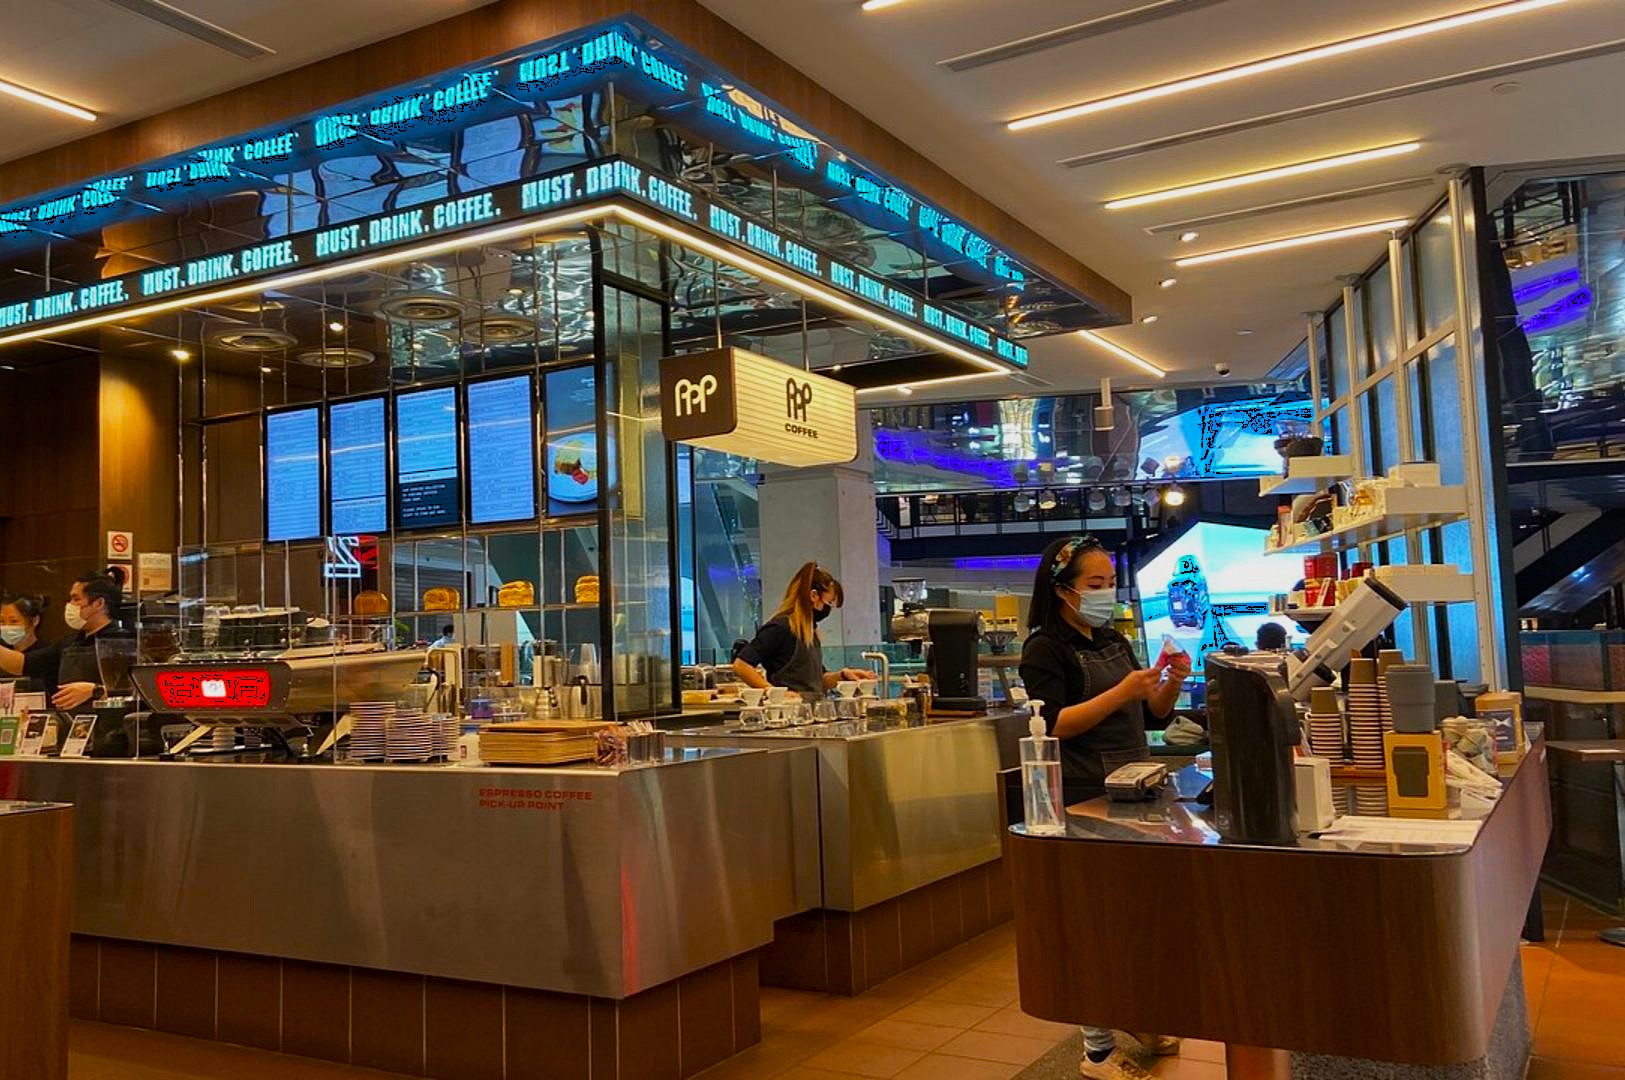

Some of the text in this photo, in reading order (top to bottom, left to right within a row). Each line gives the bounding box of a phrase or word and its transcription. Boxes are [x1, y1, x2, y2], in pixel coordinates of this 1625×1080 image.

[784, 422, 819, 439] COFFEE
[479, 788, 593, 800] ESPRESSO COFFEE
[479, 800, 565, 811] PICK-UP POINT
